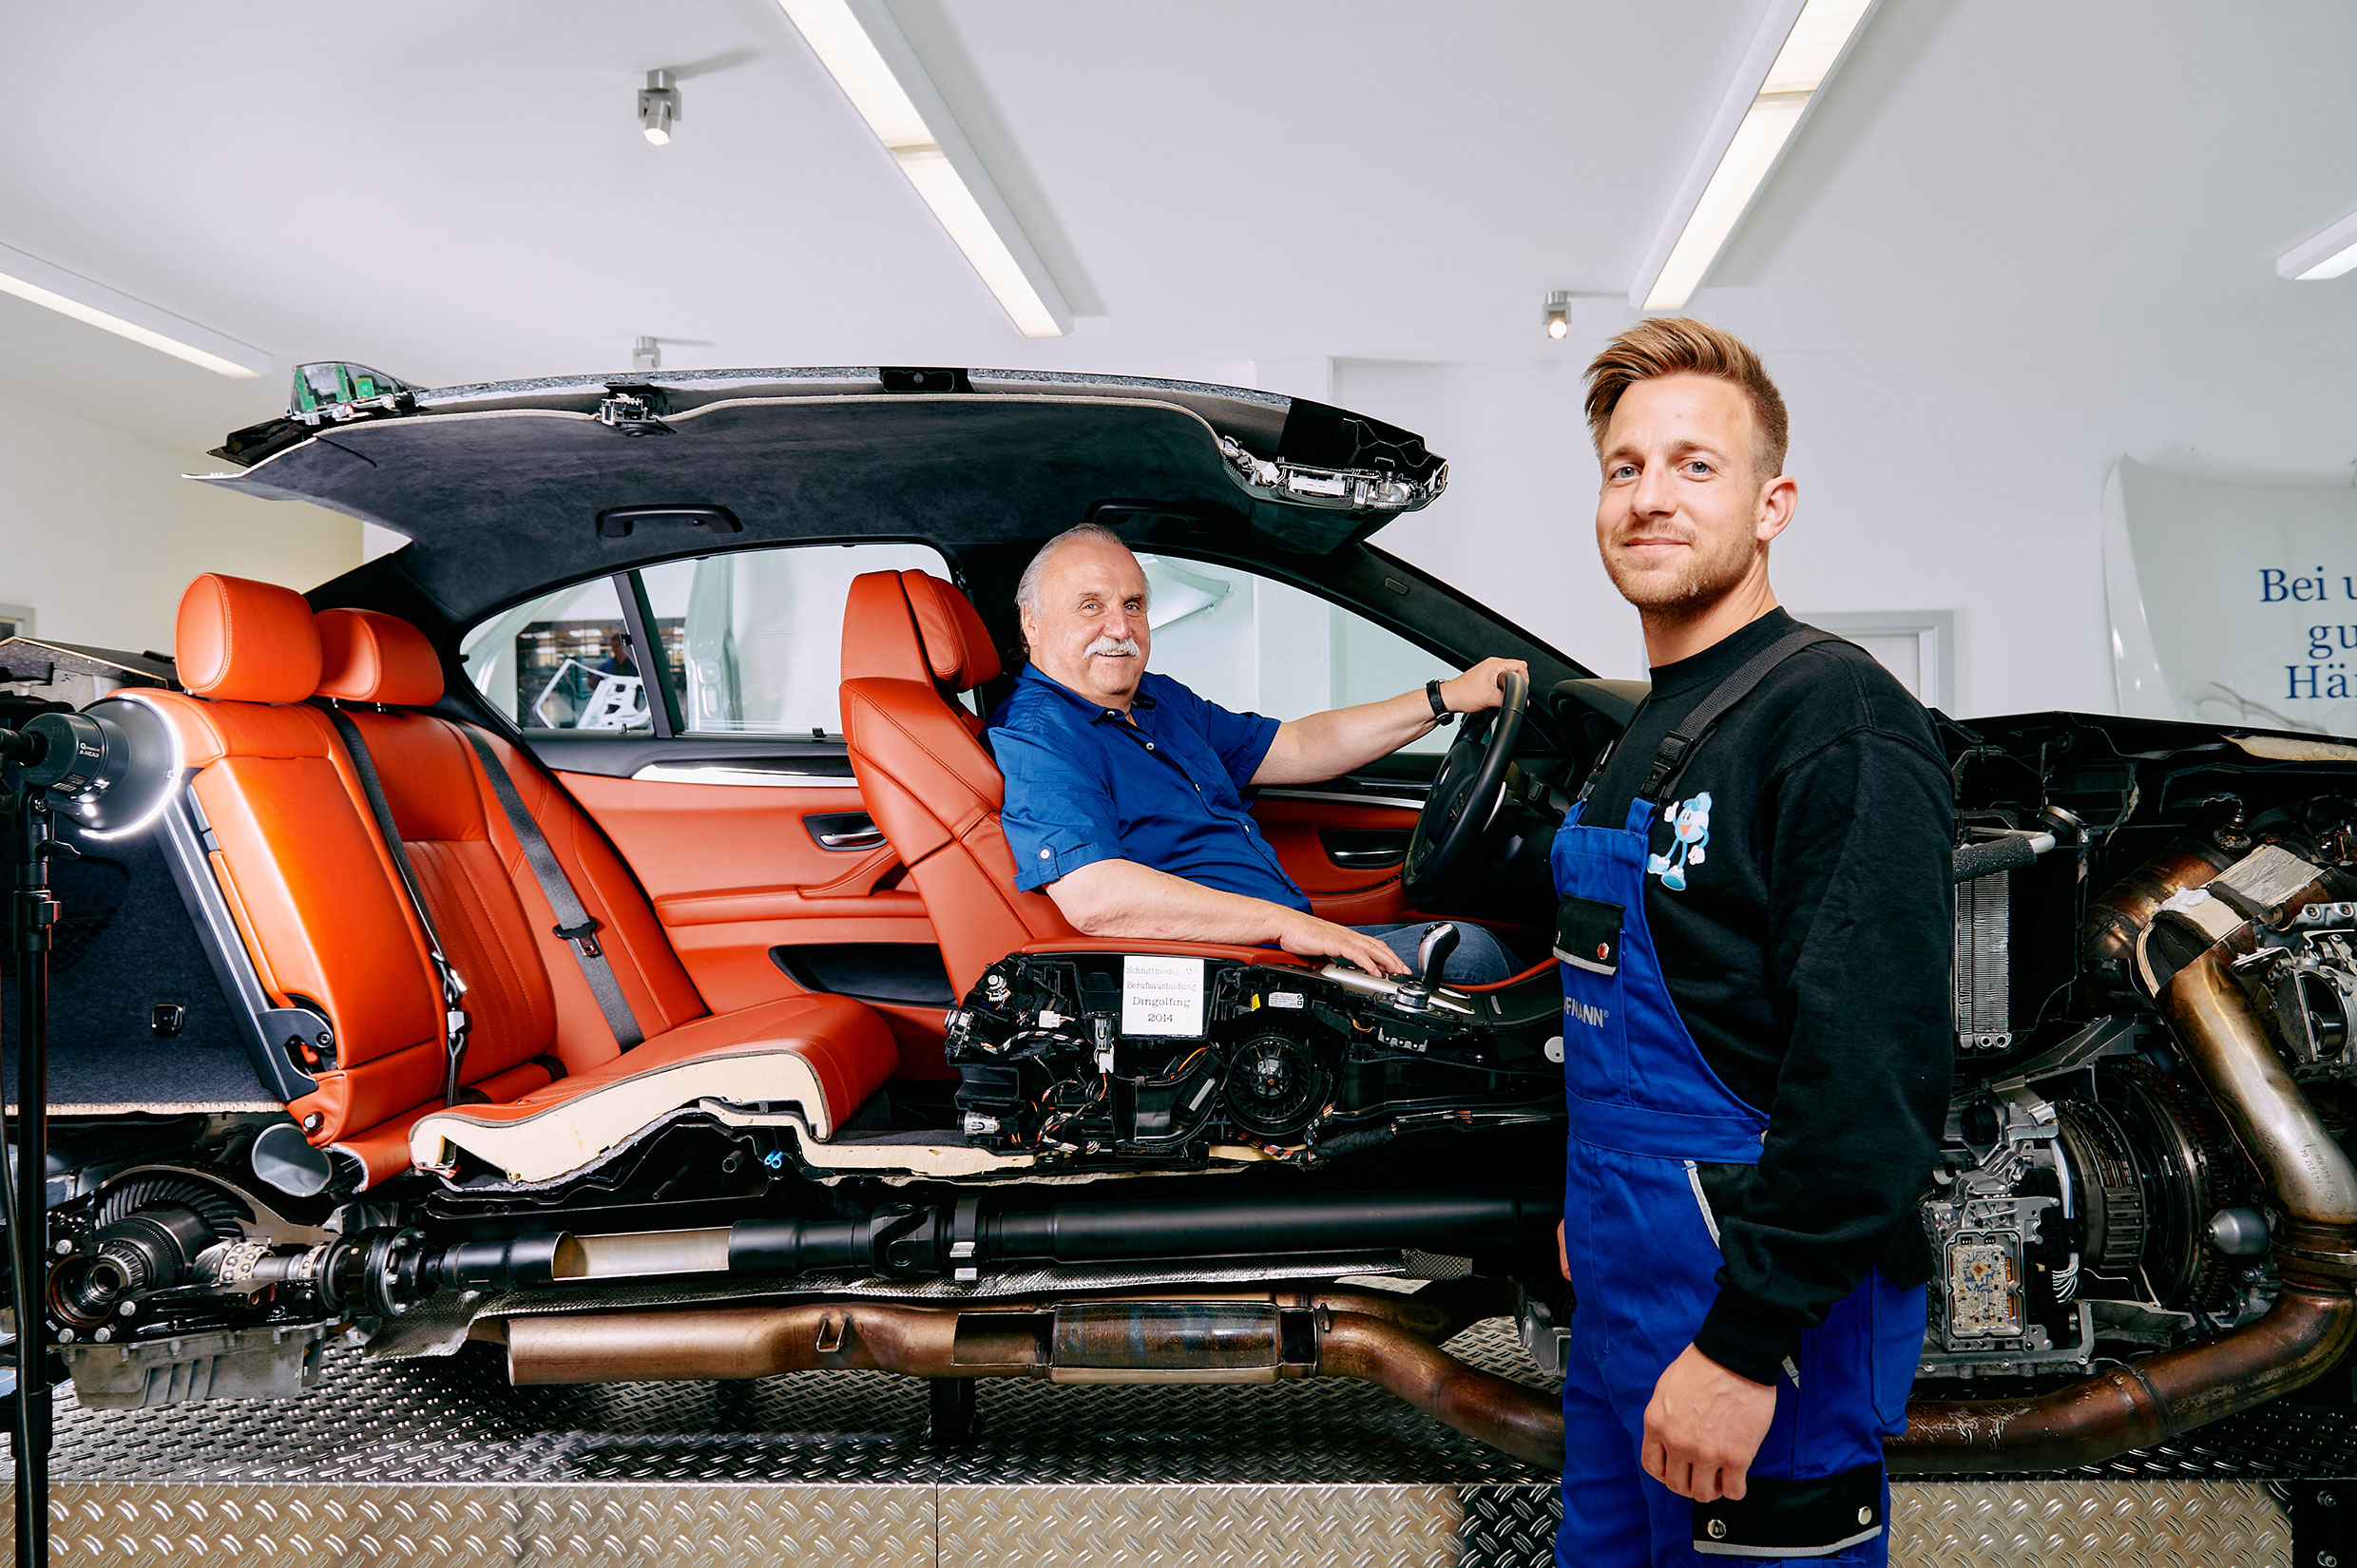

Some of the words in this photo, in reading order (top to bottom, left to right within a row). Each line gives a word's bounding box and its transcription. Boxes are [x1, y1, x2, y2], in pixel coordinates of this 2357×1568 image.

[2258, 565, 2329, 602] Bei
[2309, 624, 2357, 660] gu
[2285, 662, 2357, 699] Hä
[1132, 996, 1192, 1008] Dingolfing
[1147, 1013, 1173, 1023] 2014
